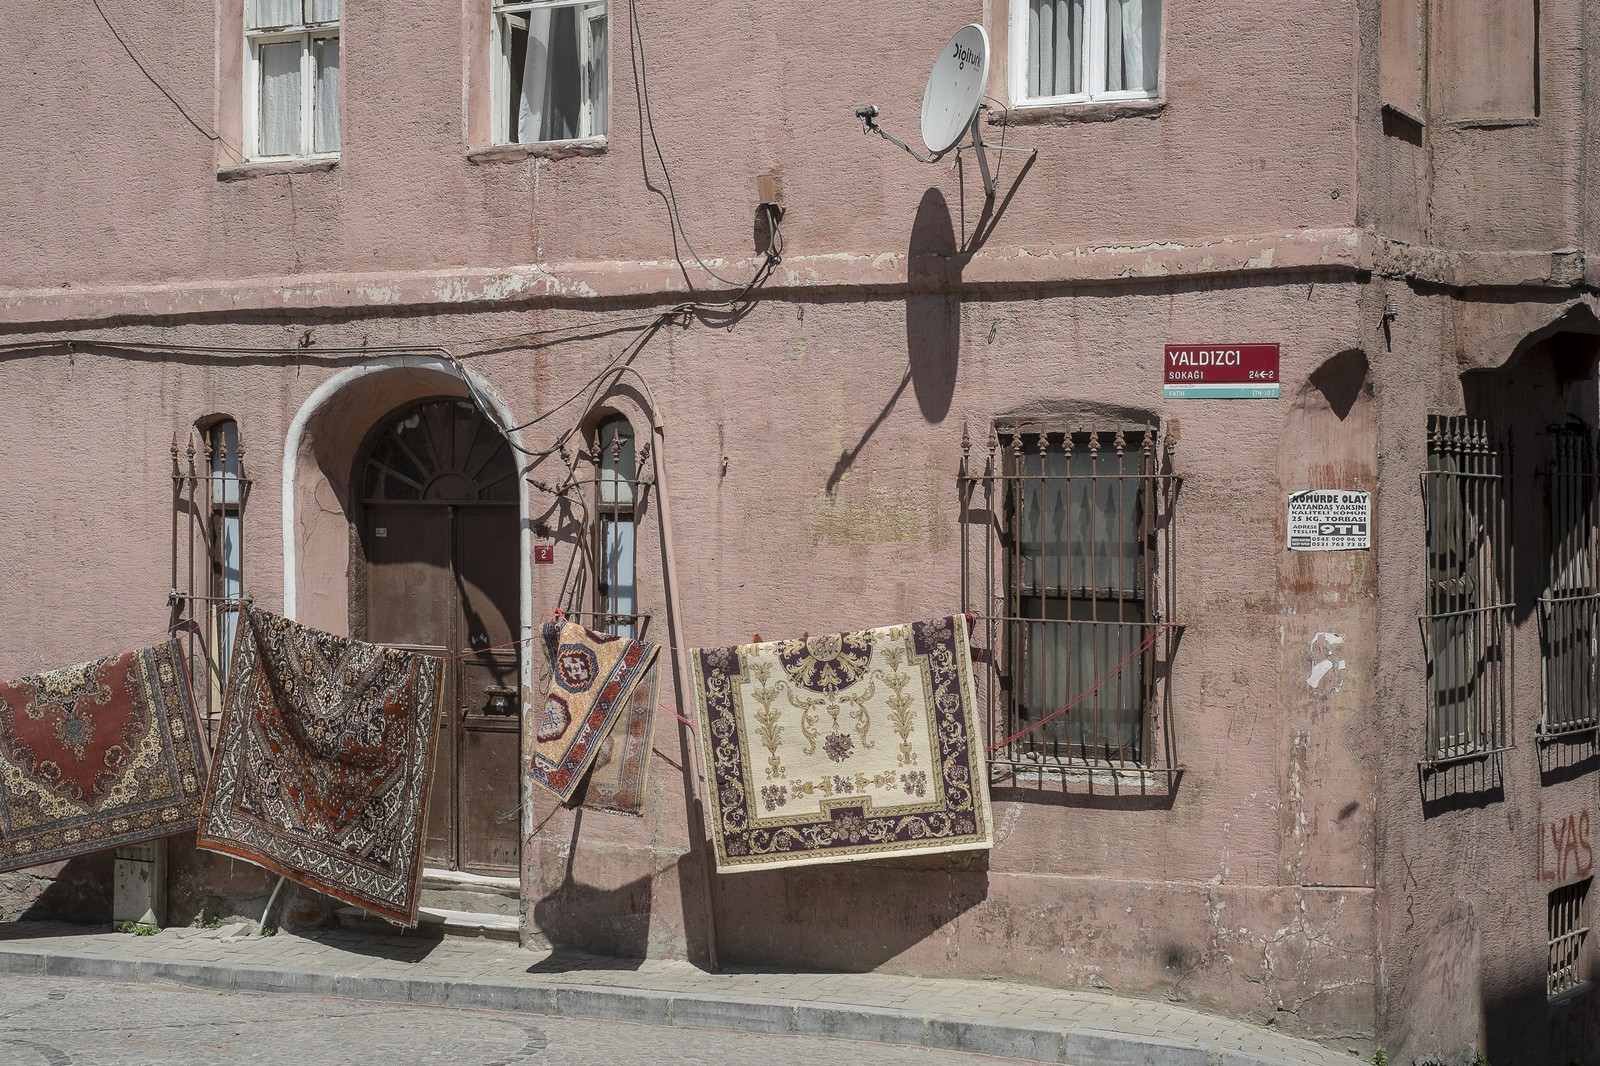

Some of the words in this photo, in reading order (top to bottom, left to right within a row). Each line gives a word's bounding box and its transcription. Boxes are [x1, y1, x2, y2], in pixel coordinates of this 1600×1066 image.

[953, 43, 982, 70] Digiturk
[1169, 351, 1240, 366] YALDIZCI
[1169, 370, 1204, 379] SOKAĞI
[1342, 495, 1367, 504] OLAY
[1319, 524, 1366, 535] 9TL
[541, 550, 546, 559] 2
